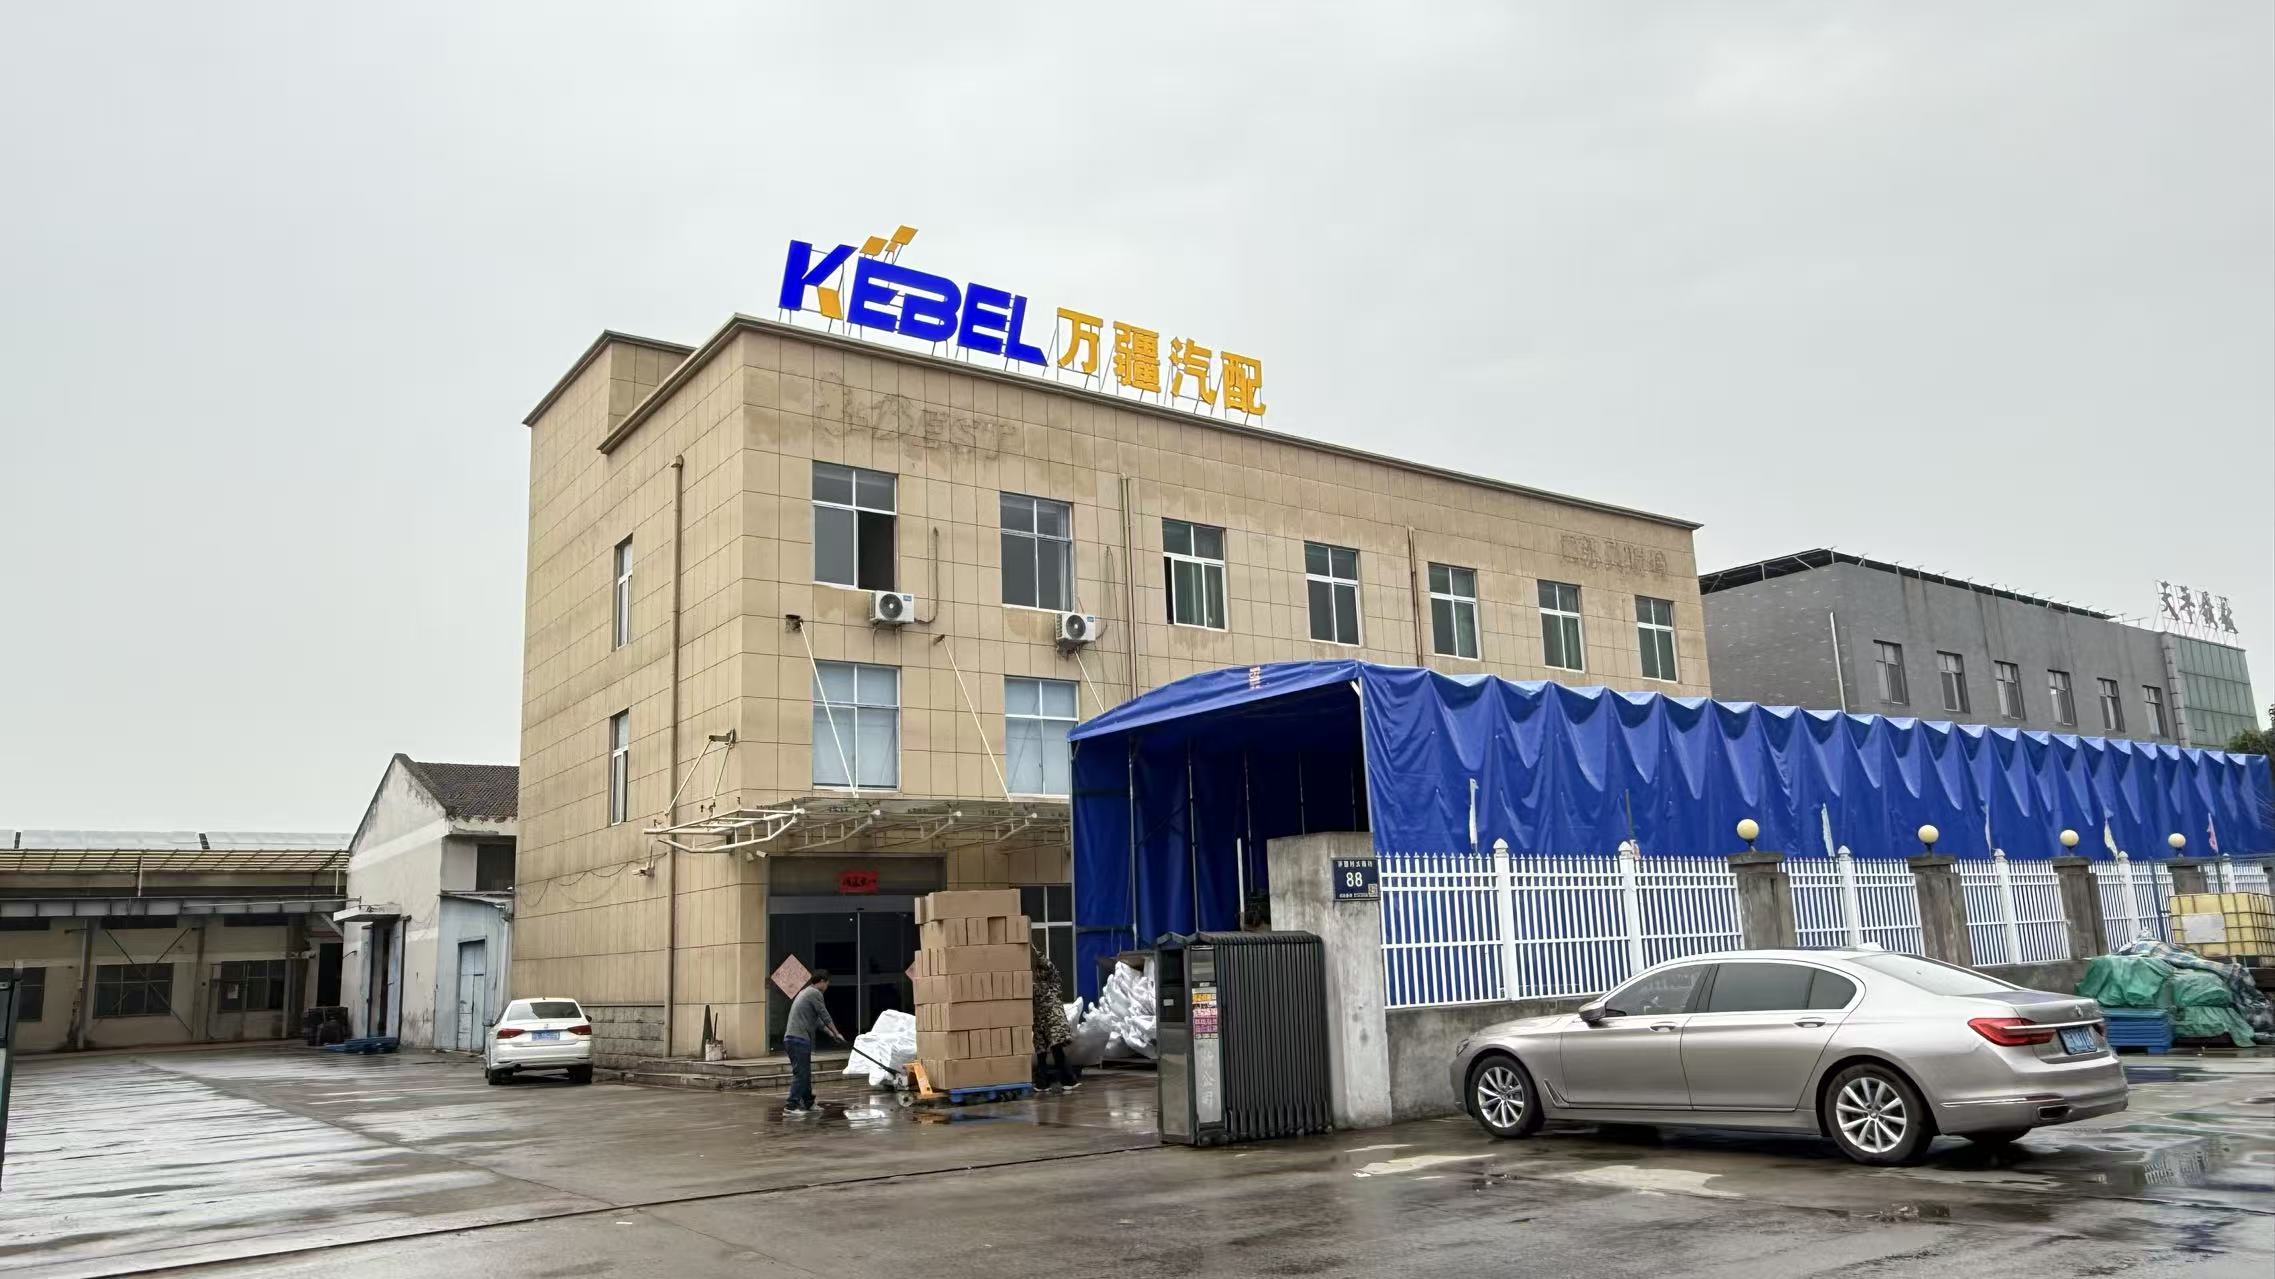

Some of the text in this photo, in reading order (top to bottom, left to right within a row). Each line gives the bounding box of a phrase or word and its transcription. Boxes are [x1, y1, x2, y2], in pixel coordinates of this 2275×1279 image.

[778, 238, 1049, 368] KEBEL
[1056, 306, 1267, 416] 万疆汽配
[1346, 871, 1363, 887] 88
